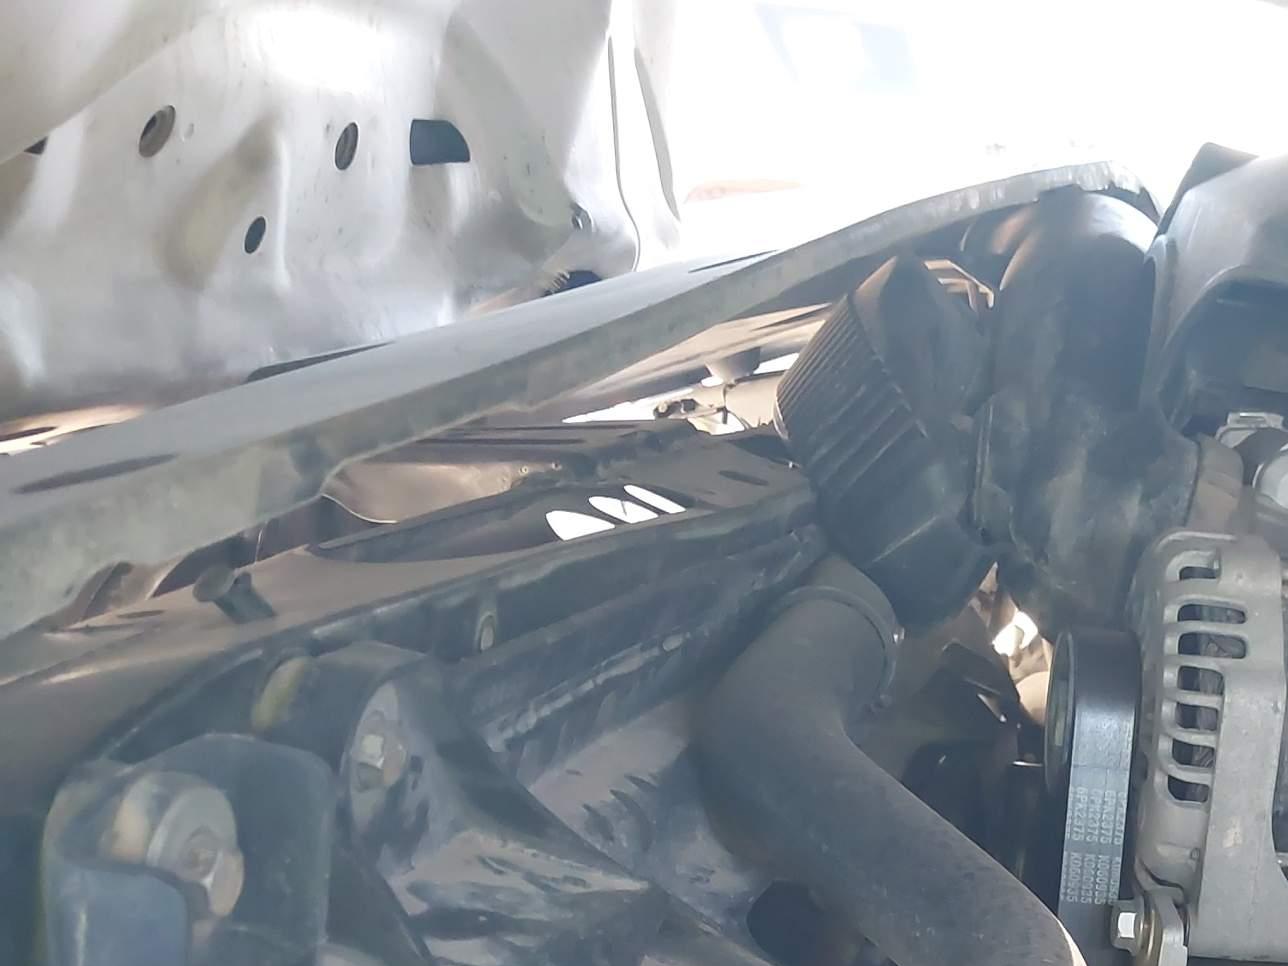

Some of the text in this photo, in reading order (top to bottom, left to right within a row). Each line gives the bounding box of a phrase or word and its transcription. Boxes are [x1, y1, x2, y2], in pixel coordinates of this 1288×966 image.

[1072, 786, 1088, 841] 6PK2375
[1094, 790, 1117, 905] 6PK2375 K060935
[1066, 851, 1082, 903] K060935
[1079, 853, 1096, 904] K060935
